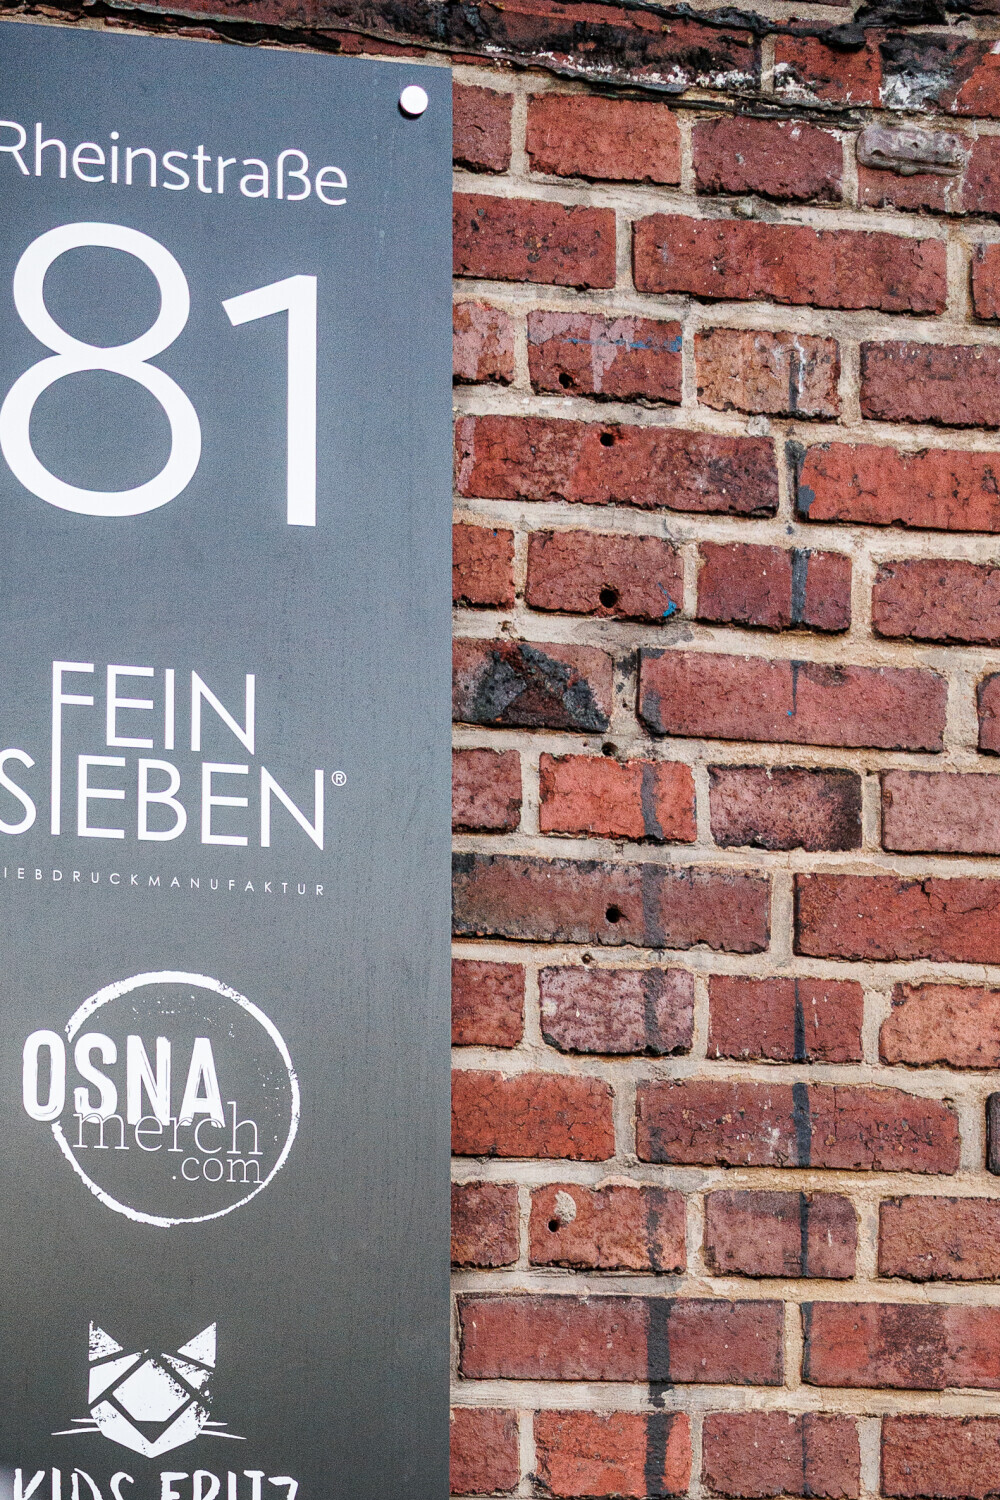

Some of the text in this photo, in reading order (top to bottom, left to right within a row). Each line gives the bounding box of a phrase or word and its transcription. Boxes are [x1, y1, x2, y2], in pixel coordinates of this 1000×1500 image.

[0, 221, 318, 527] 81
[51, 660, 256, 756] FEIN
[22, 1029, 226, 1128] OSNA
[72, 1101, 264, 1156] merch
